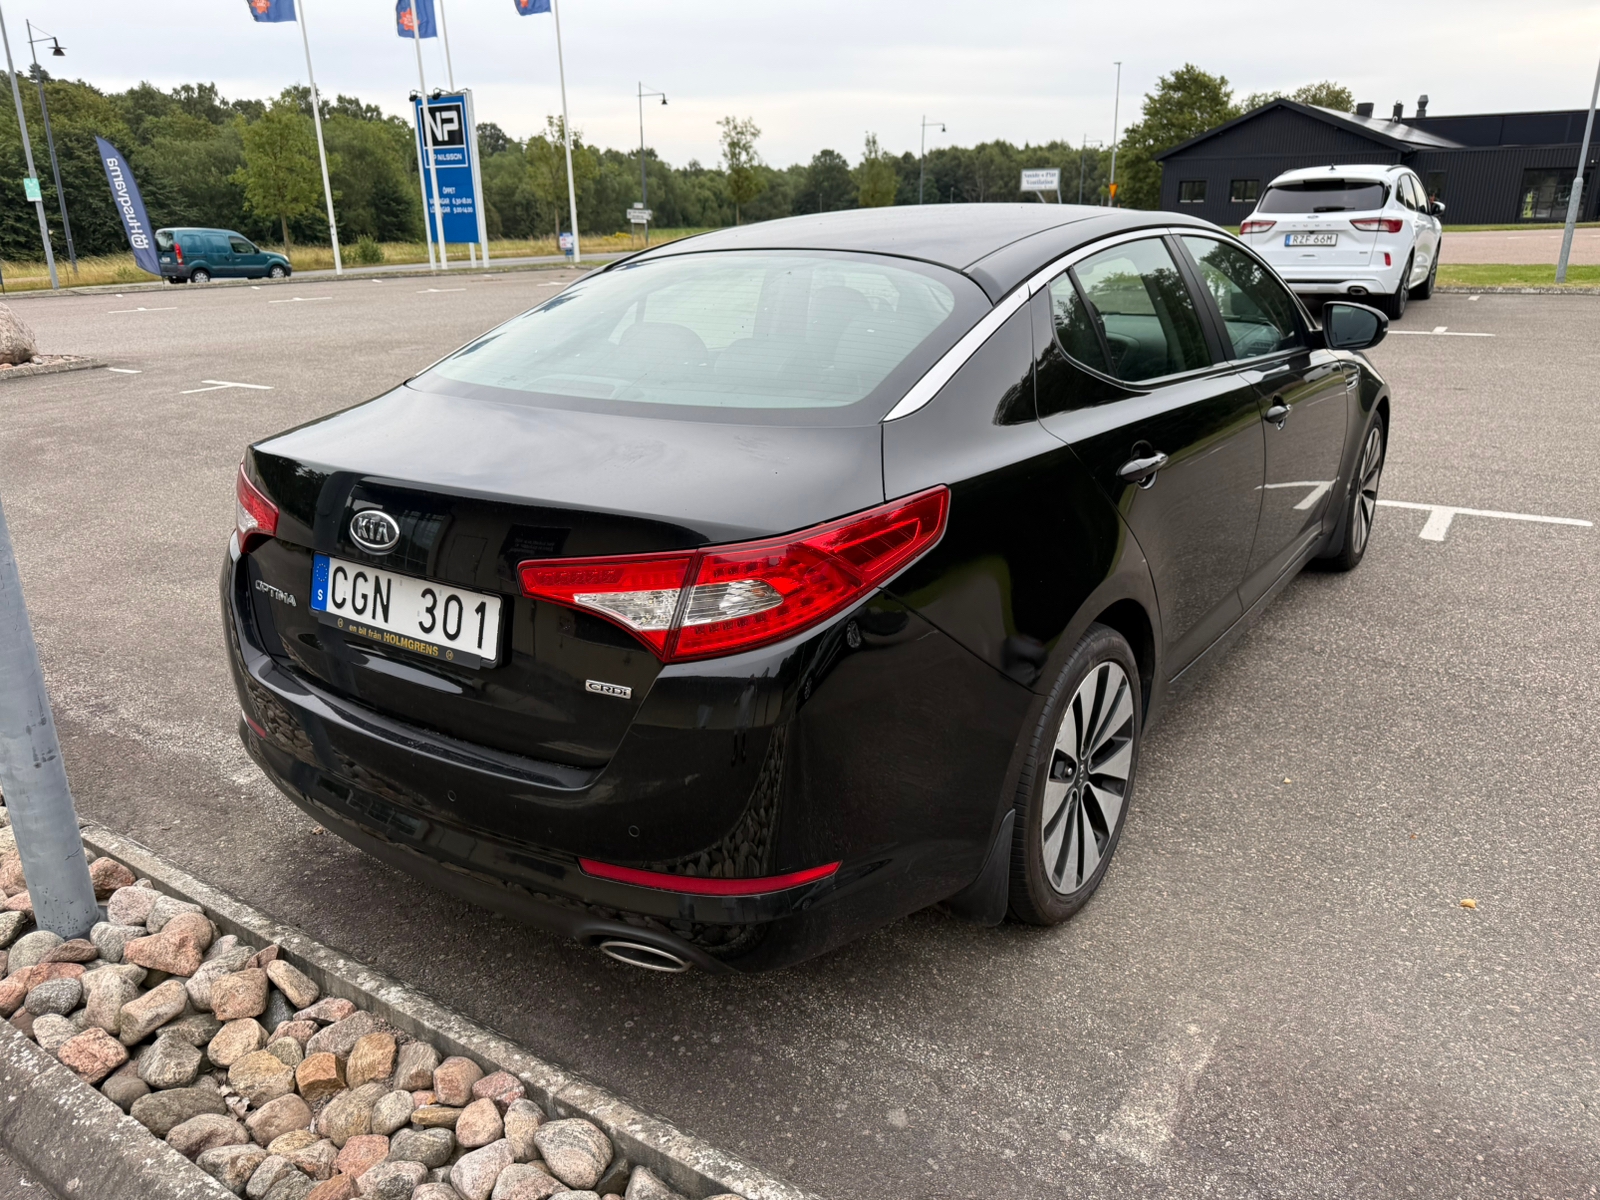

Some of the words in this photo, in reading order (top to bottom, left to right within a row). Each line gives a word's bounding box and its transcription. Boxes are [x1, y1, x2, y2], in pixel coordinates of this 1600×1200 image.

[427, 110, 459, 141] NP
[1293, 235, 1311, 244] RZF
[1313, 235, 1333, 244] 66M
[357, 517, 390, 543] KIA
[255, 579, 297, 607] OPTIMA
[317, 589, 323, 601] S
[331, 566, 392, 623] CGN
[418, 587, 487, 650] 301
[358, 626, 367, 636] bil
[368, 629, 382, 640] från
[383, 632, 439, 657] HOLMGRENS
